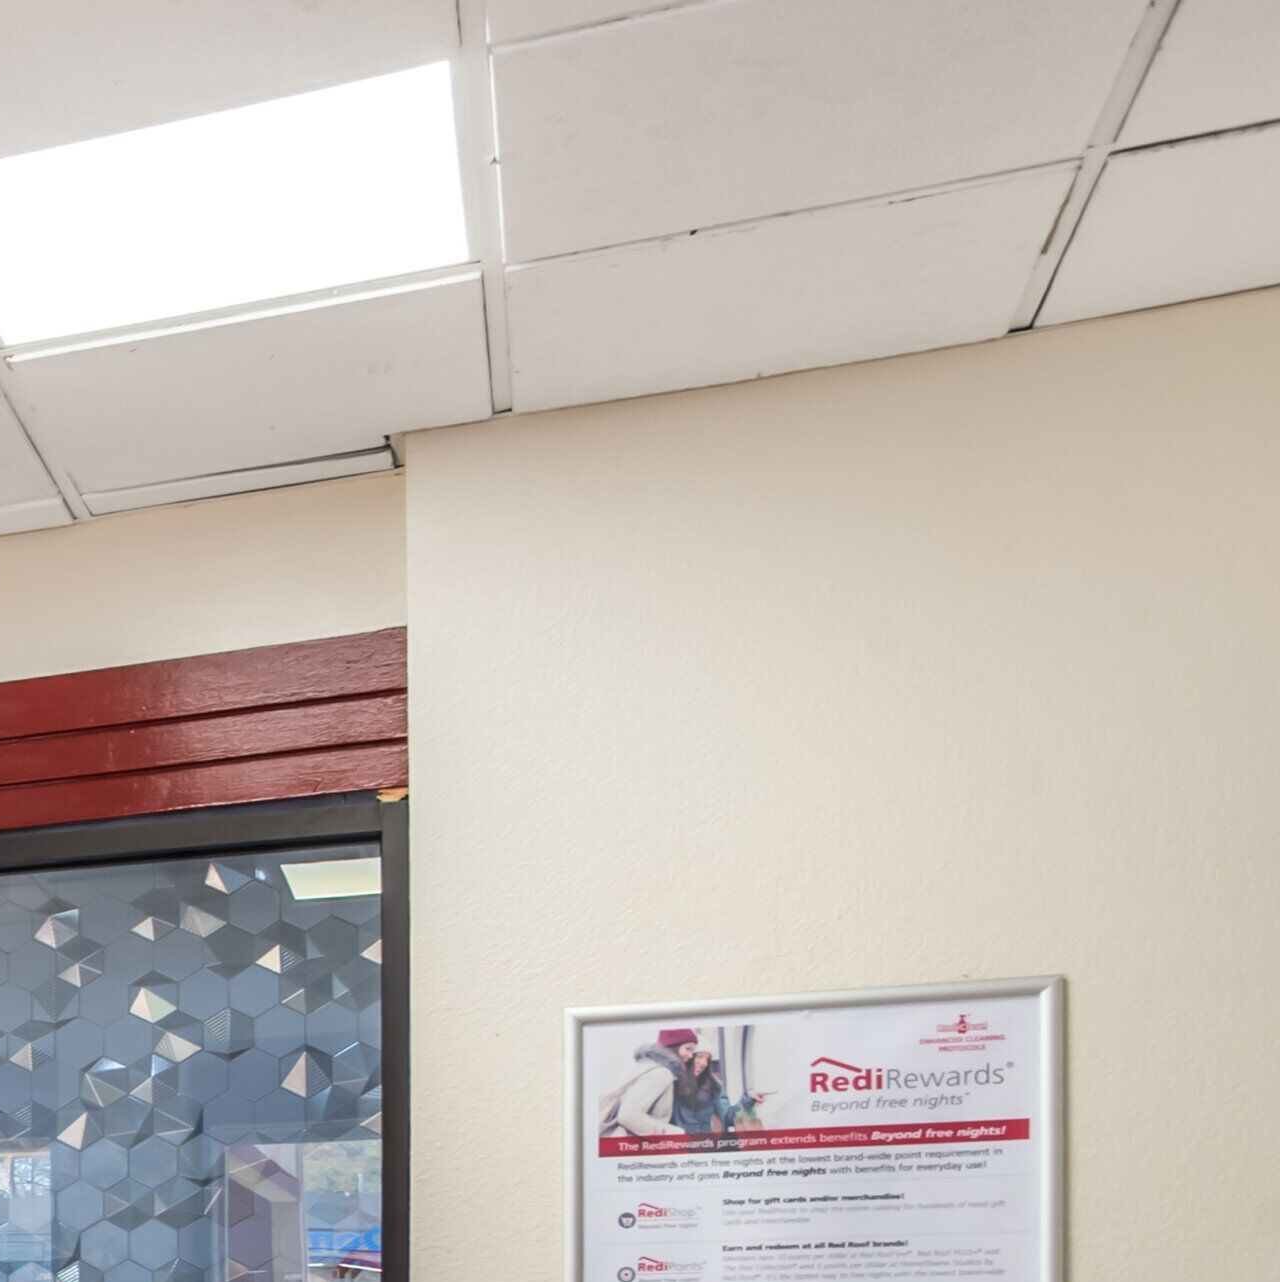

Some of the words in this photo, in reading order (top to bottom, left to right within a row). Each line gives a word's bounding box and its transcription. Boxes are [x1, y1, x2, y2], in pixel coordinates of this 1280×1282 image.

[811, 1101, 869, 1114] Beyond
[875, 1096, 907, 1108] free
[617, 1141, 639, 1151] The
[641, 1139, 714, 1151] RediRewards
[716, 1137, 767, 1149] program
[769, 1134, 816, 1144] extends
[819, 1131, 868, 1142] benefits
[870, 1129, 922, 1142] Beyond
[925, 1127, 953, 1138] free
[956, 1125, 1006, 1139] nights!
[617, 1160, 678, 1170] RediRewards
[680, 1159, 708, 1168] offers
[710, 1158, 730, 1167] free
[732, 1157, 763, 1167] nights
[778, 1155, 795, 1164] the
[798, 1154, 830, 1163] lowest
[833, 1151, 892, 1162] brand-wide
[894, 1151, 921, 1160] point
[924, 1148, 989, 1158] requirement
[617, 1174, 633, 1182] the
[635, 1173, 674, 1183] industry
[675, 1172, 695, 1180] and
[696, 1172, 720, 1181] goes
[722, 1169, 764, 1180] Beyond
[766, 1167, 788, 1176] free
[791, 1166, 826, 1177] nights
[829, 1165, 852, 1174] with
[854, 1163, 896, 1173] benefits
[898, 1162, 914, 1171] for
[916, 1161, 963, 1172] everyday
[965, 1160, 986, 1169] use!
[763, 1196, 780, 1205] gift
[841, 1192, 904, 1201] merchandise!
